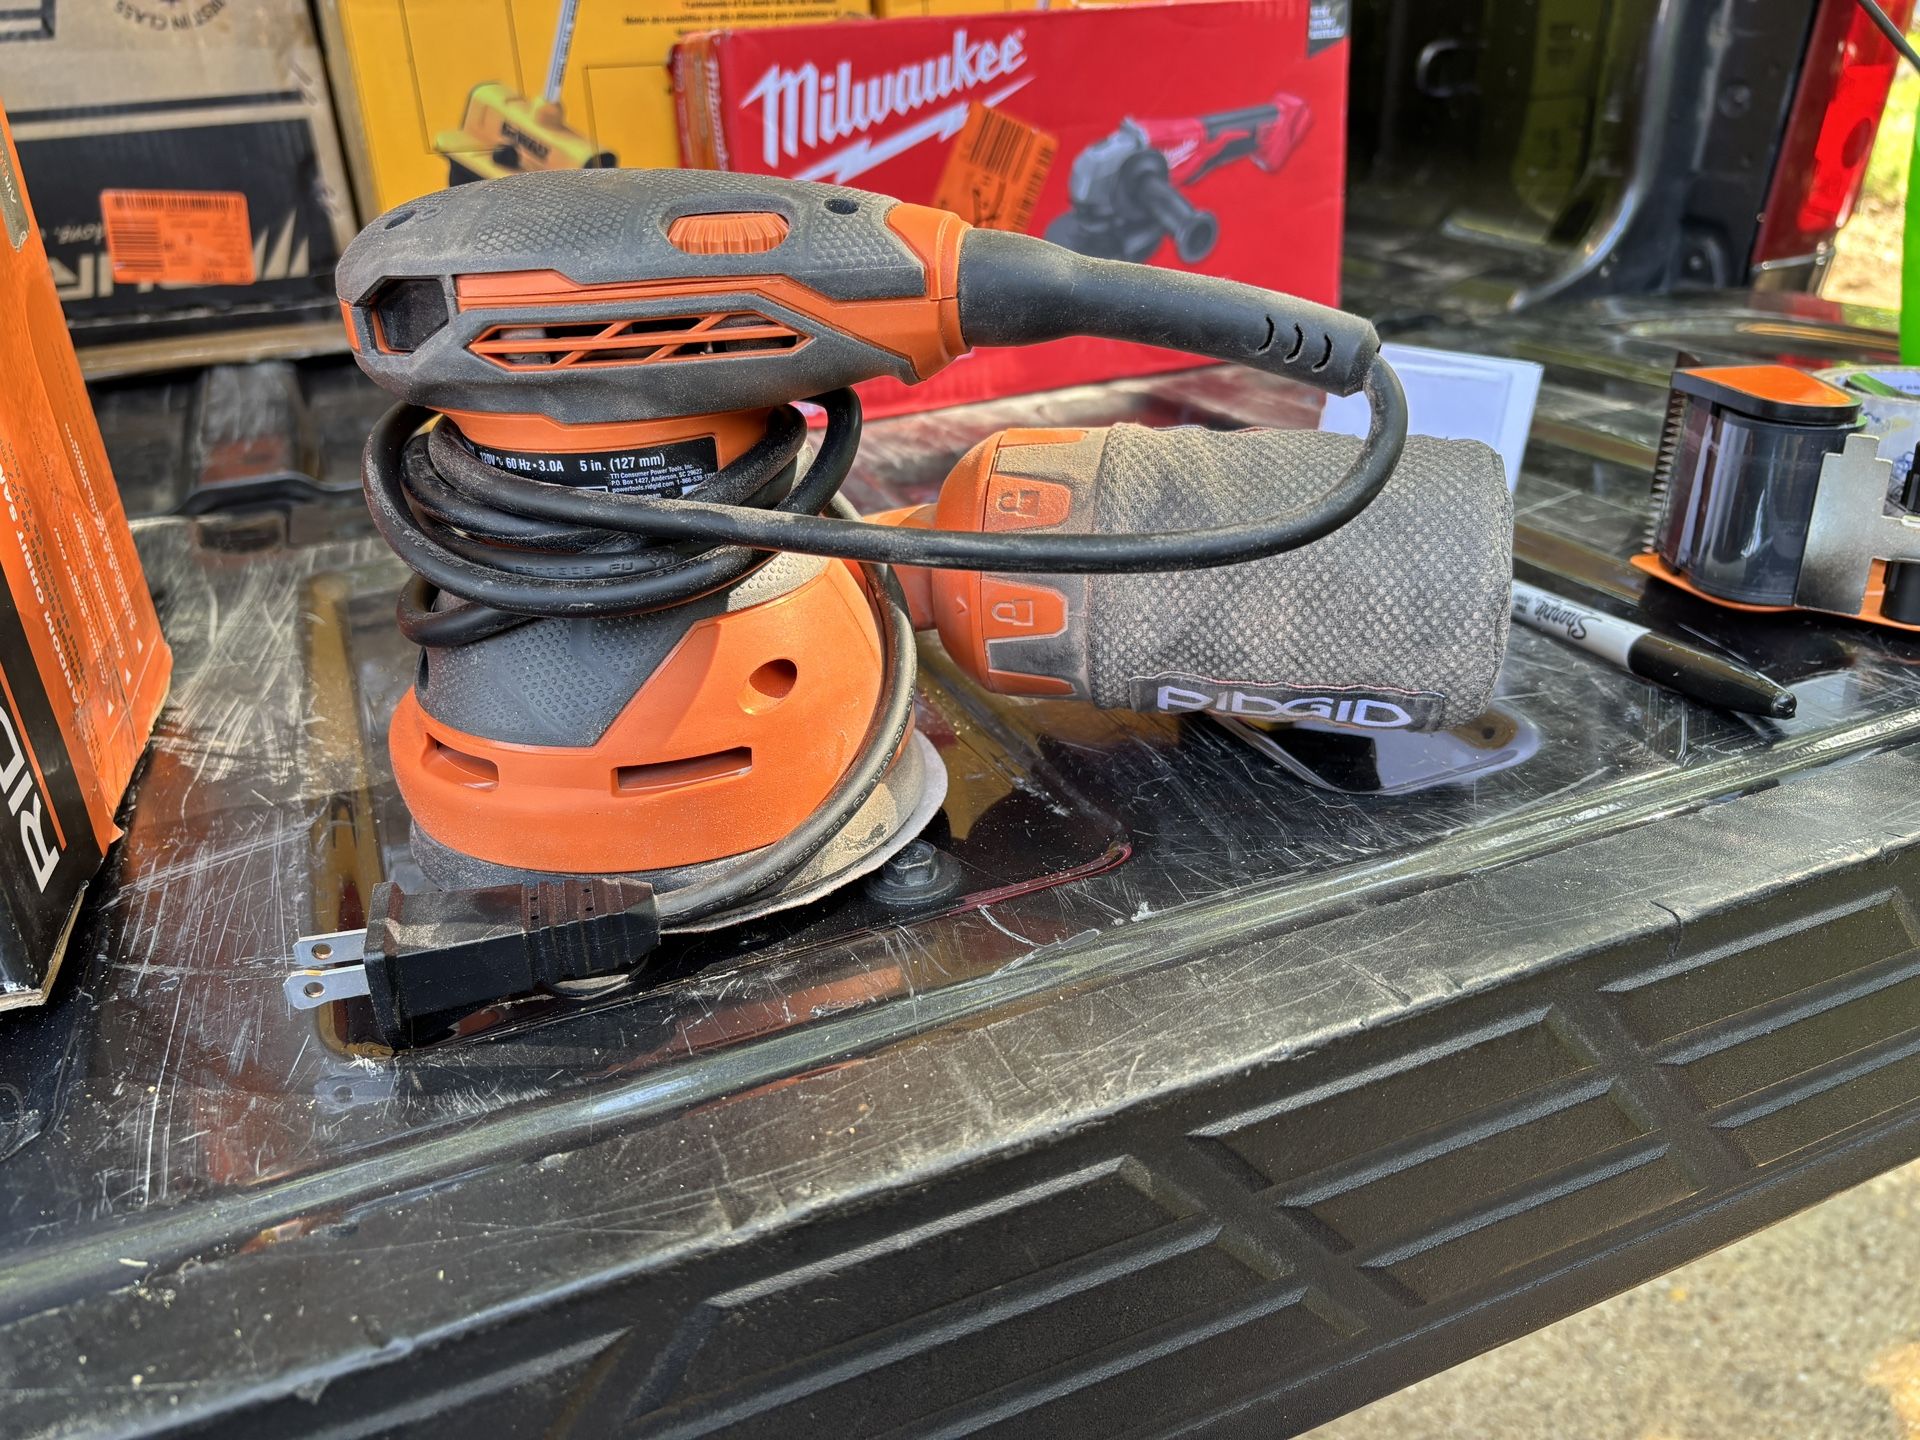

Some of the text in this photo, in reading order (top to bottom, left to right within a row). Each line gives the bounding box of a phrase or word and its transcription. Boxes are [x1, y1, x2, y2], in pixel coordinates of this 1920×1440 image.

[740, 28, 1027, 168] Milwaukee
[505, 457, 517, 469] 60
[580, 460, 587, 472] 5
[590, 459, 606, 472] in.
[610, 456, 634, 472] (127
[639, 452, 665, 467] mm)
[620, 471, 649, 479] Consumer
[650, 468, 667, 476] Power
[7, 471, 20, 503] 127
[611, 481, 674, 493] powertools.ridgid.com
[622, 478, 633, 486] Box
[20, 487, 32, 517] 127
[16, 529, 45, 605] ORBIT
[609, 561, 634, 573] FU
[1535, 600, 1603, 640] Sharpie
[44, 610, 80, 704] ANDOM
[853, 790, 867, 808] FU
[871, 750, 894, 783] YUAN
